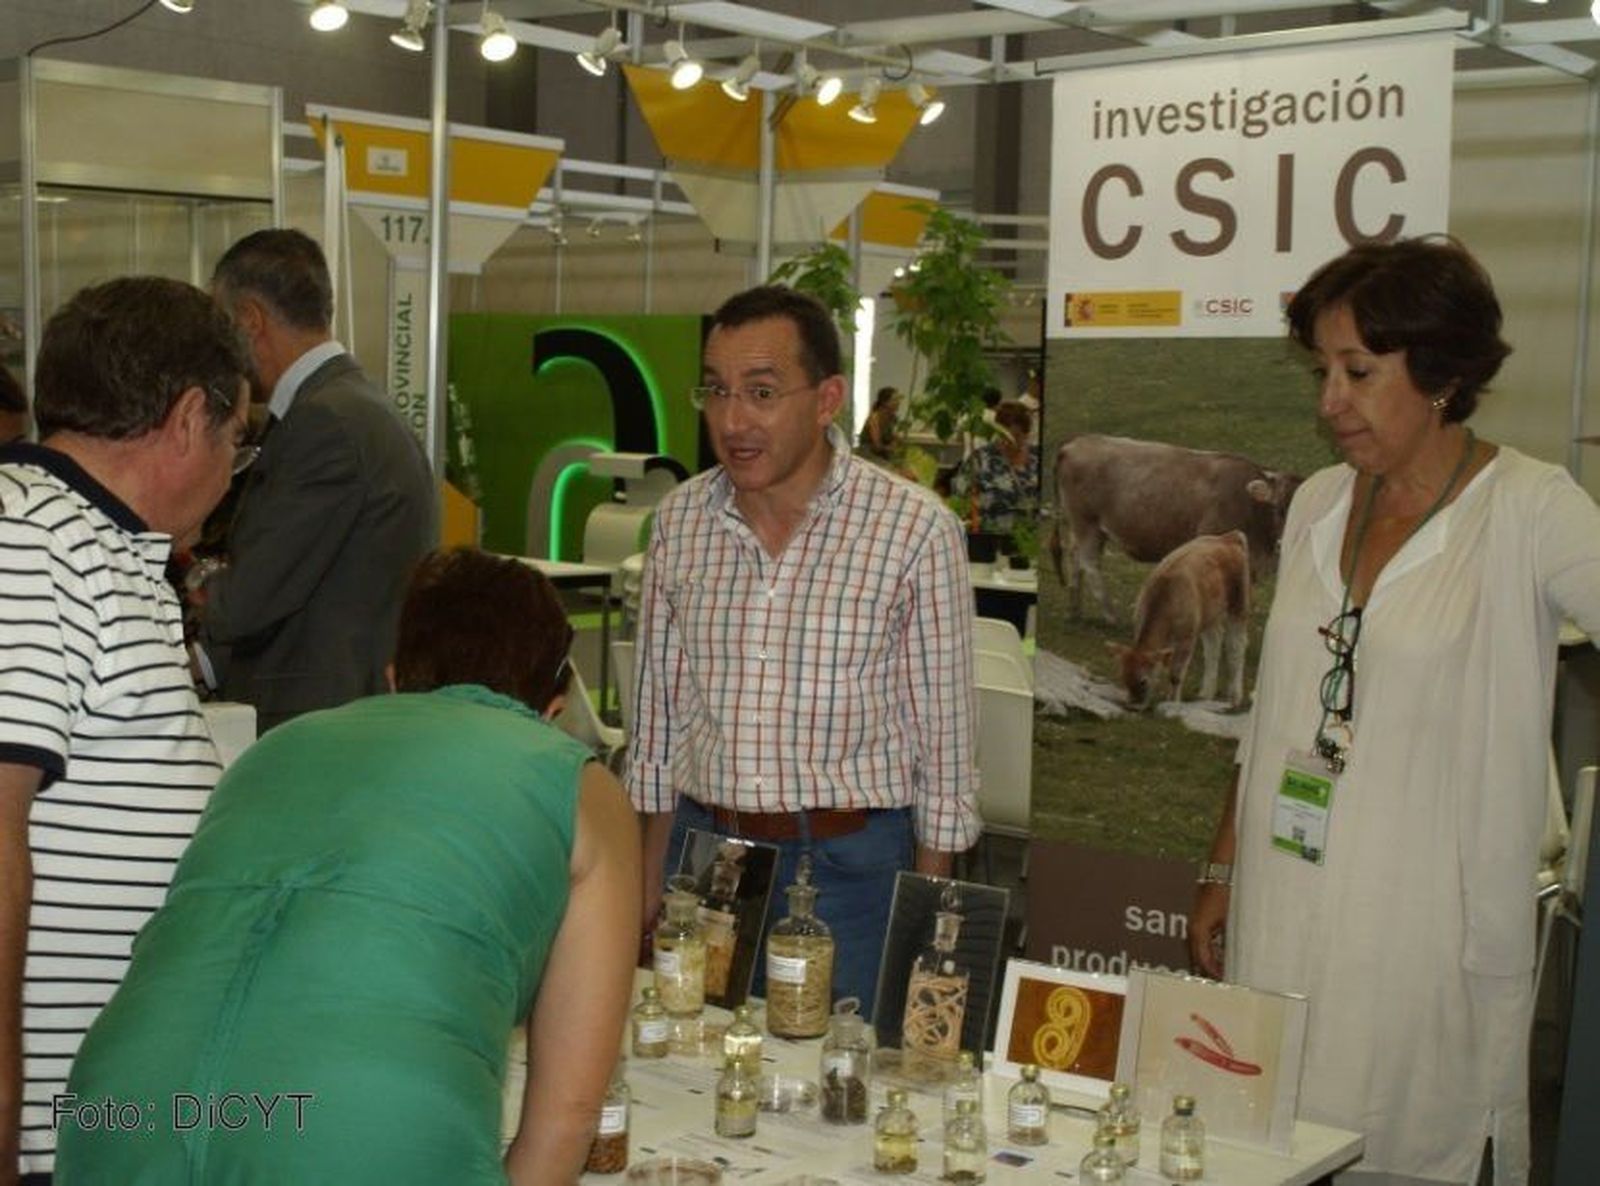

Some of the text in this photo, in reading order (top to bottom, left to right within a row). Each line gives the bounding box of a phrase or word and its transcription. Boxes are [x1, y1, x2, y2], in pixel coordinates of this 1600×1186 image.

[1093, 73, 1405, 139] investigación
[1081, 146, 1407, 260] CSIC
[1205, 298, 1254, 314] CSIC
[1051, 945, 1188, 978] prod
